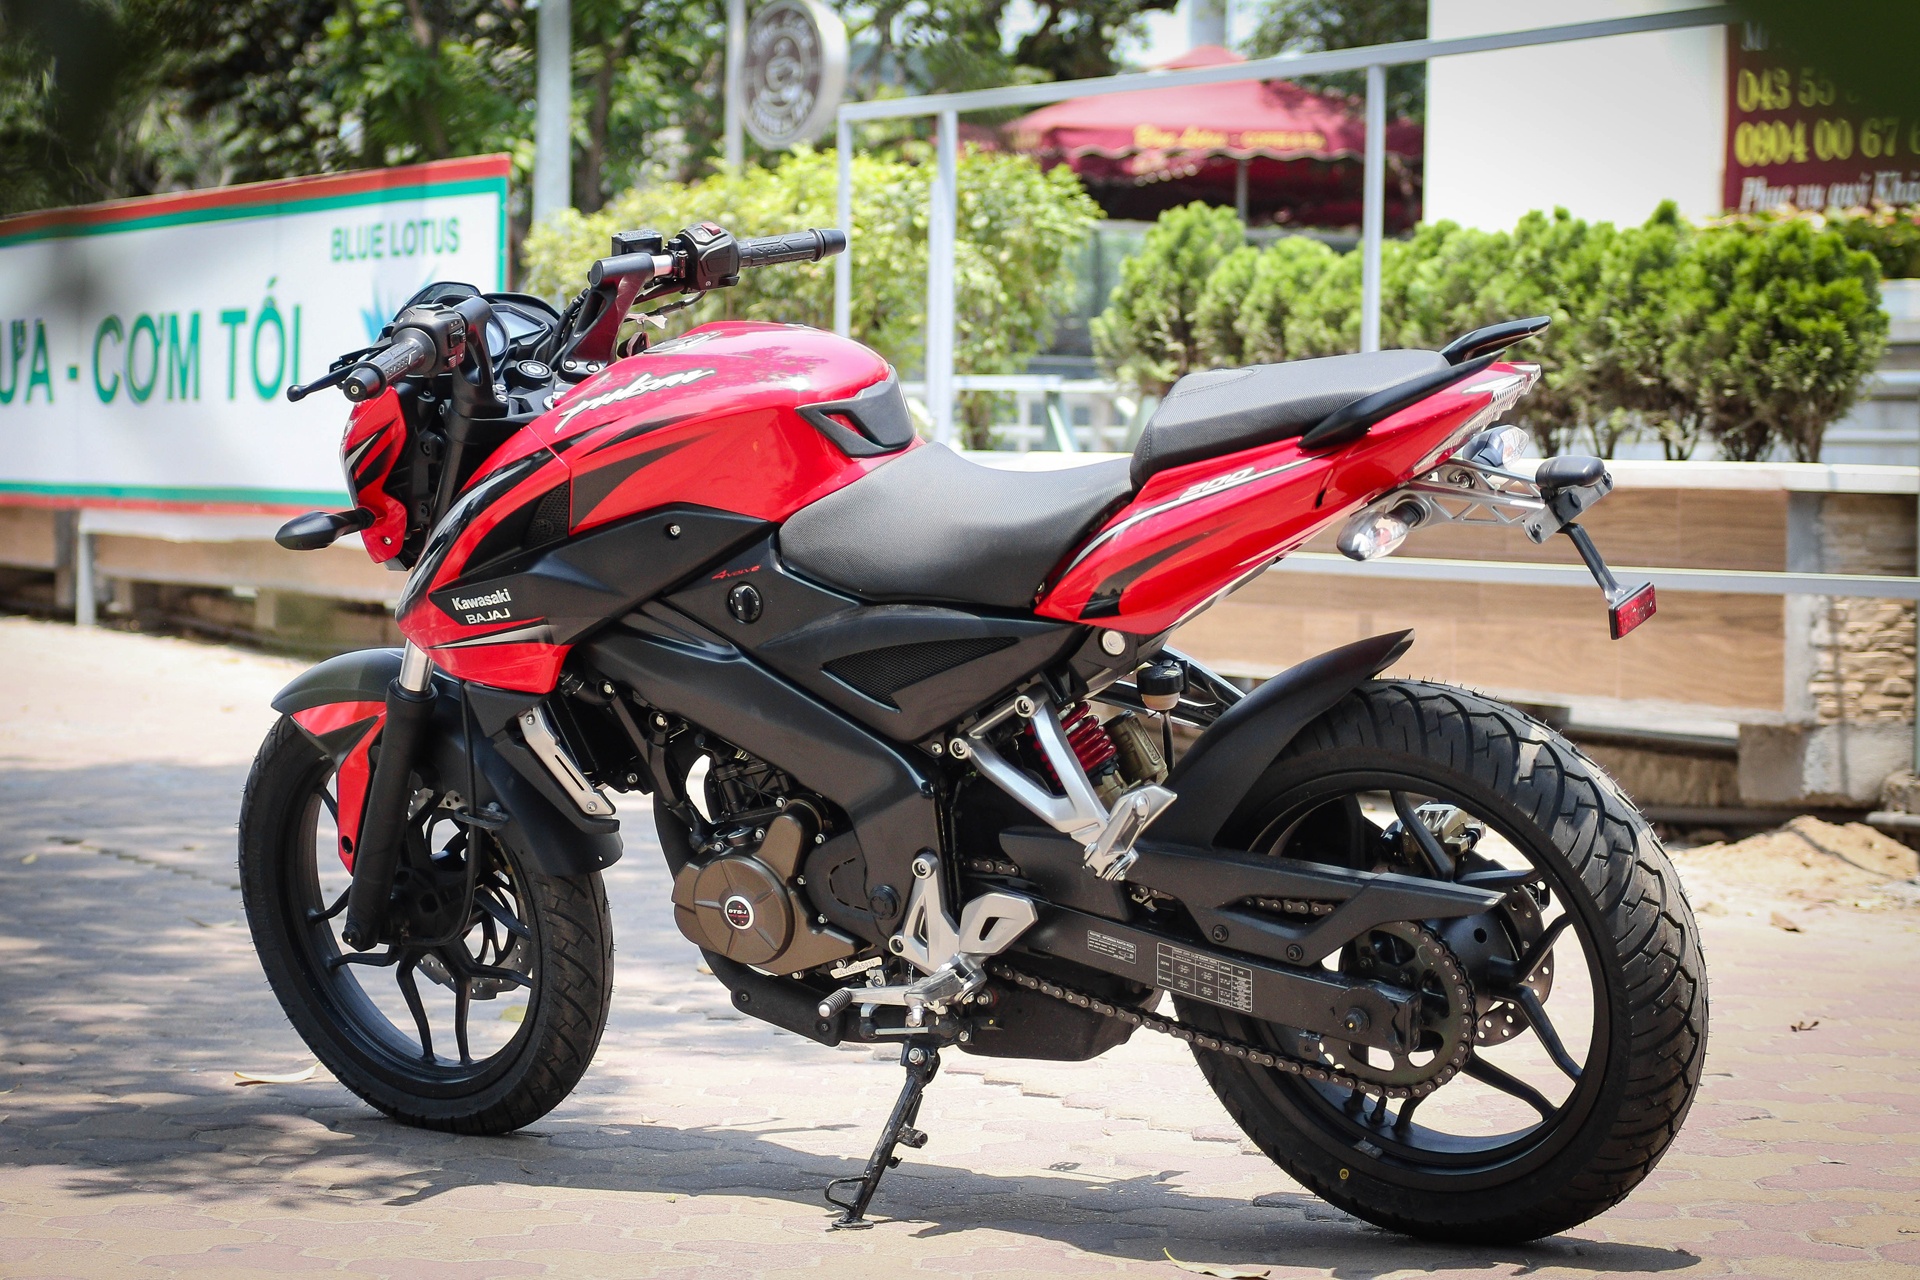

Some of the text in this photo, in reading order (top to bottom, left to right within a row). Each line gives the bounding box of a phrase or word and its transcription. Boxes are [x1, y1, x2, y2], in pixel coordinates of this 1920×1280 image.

[331, 216, 460, 262] BLUE LOTUS
[93, 312, 202, 404] CƠM
[219, 275, 301, 401] TỐI
[451, 587, 511, 611] Kawasaki
[465, 607, 511, 625] BAJAJ
